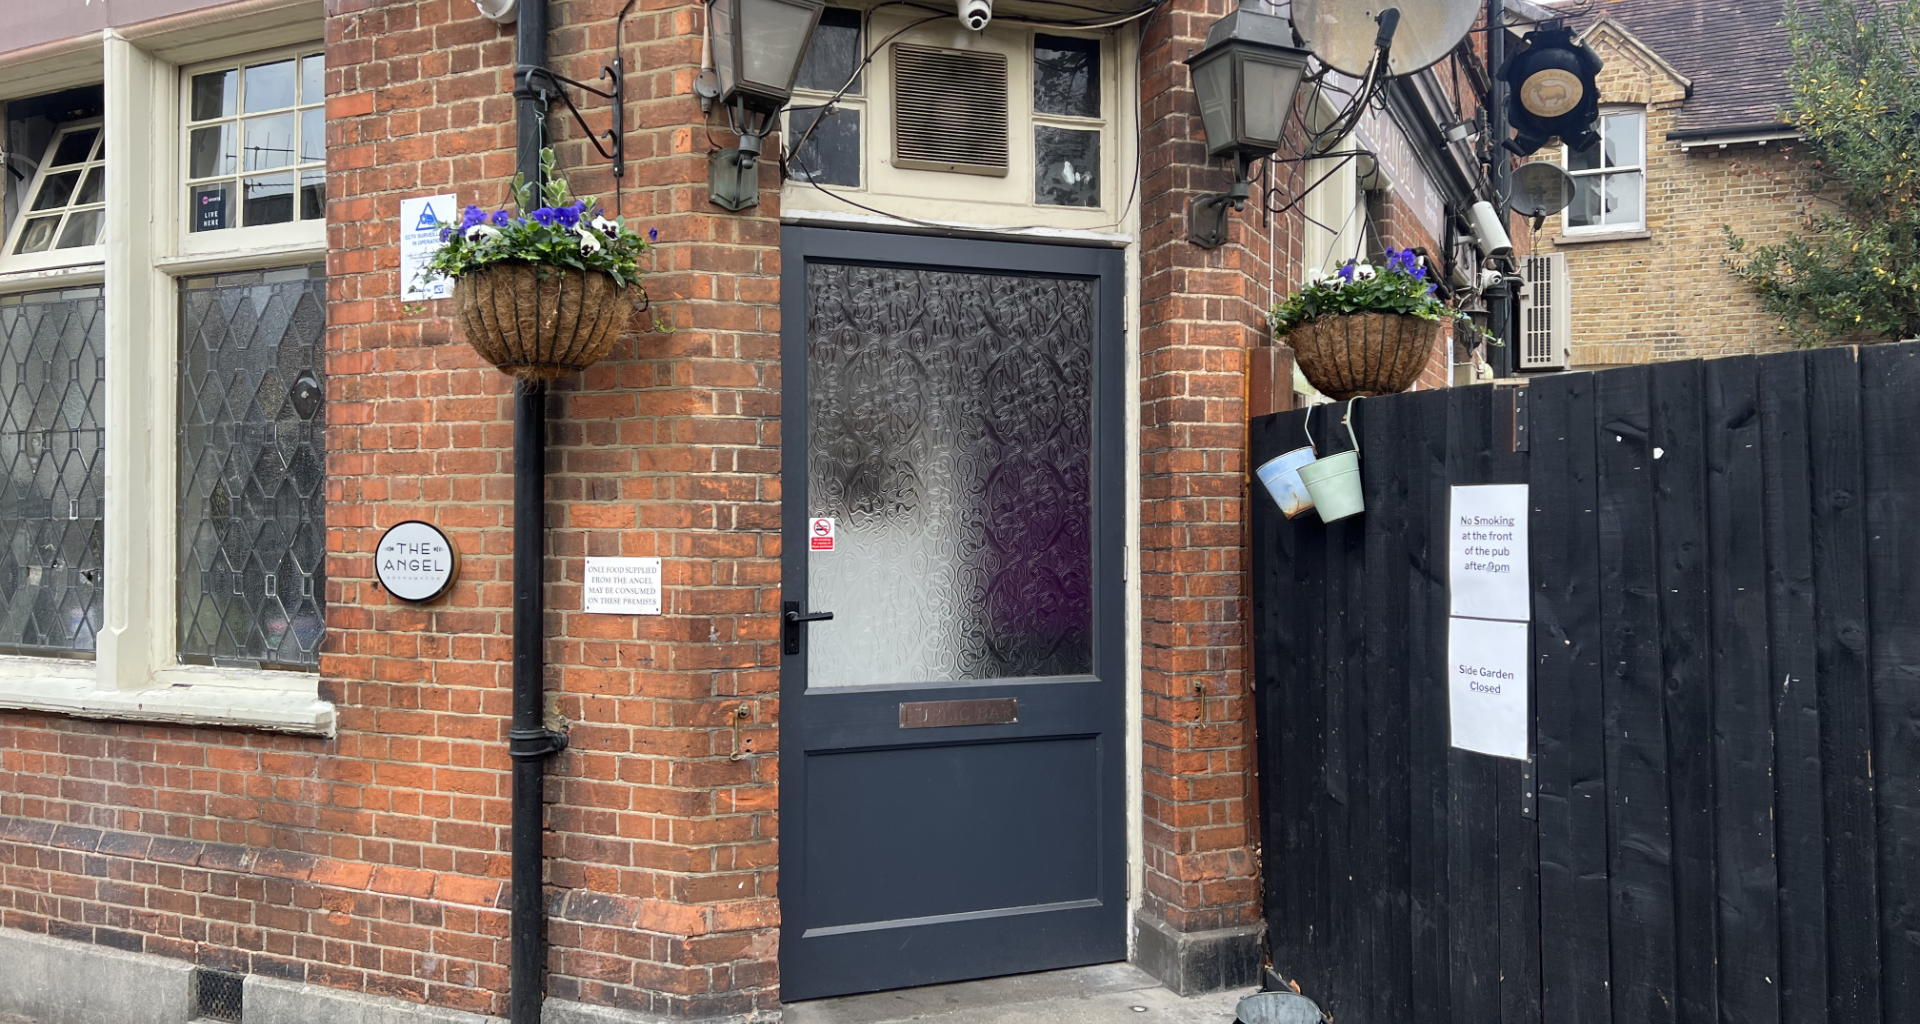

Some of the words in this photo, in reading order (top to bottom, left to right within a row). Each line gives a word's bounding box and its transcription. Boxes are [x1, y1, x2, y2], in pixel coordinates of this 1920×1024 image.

[1383, 117, 1415, 199] ANGEL
[204, 210, 219, 219] LIVE
[203, 218, 219, 227] HERE
[417, 237, 440, 246] OPERATIO
[1461, 516, 1472, 525] No
[1474, 516, 1515, 527] Smoking
[1462, 531, 1471, 540] at
[1472, 531, 1487, 540] the
[1489, 531, 1513, 541] front
[396, 542, 430, 555] THE
[1464, 546, 1473, 555] of
[1475, 546, 1490, 556] the
[1492, 546, 1510, 557] pub
[383, 559, 444, 572] ANGEL
[606, 566, 624, 574] FOOD
[625, 566, 657, 574] SUPPLIED
[1464, 561, 1486, 571] after
[615, 587, 656, 595] CONSUMED
[1459, 664, 1478, 676] Side
[1479, 667, 1514, 680] Garden
[1470, 681, 1501, 694] Closed
[978, 704, 1014, 720] BAR
